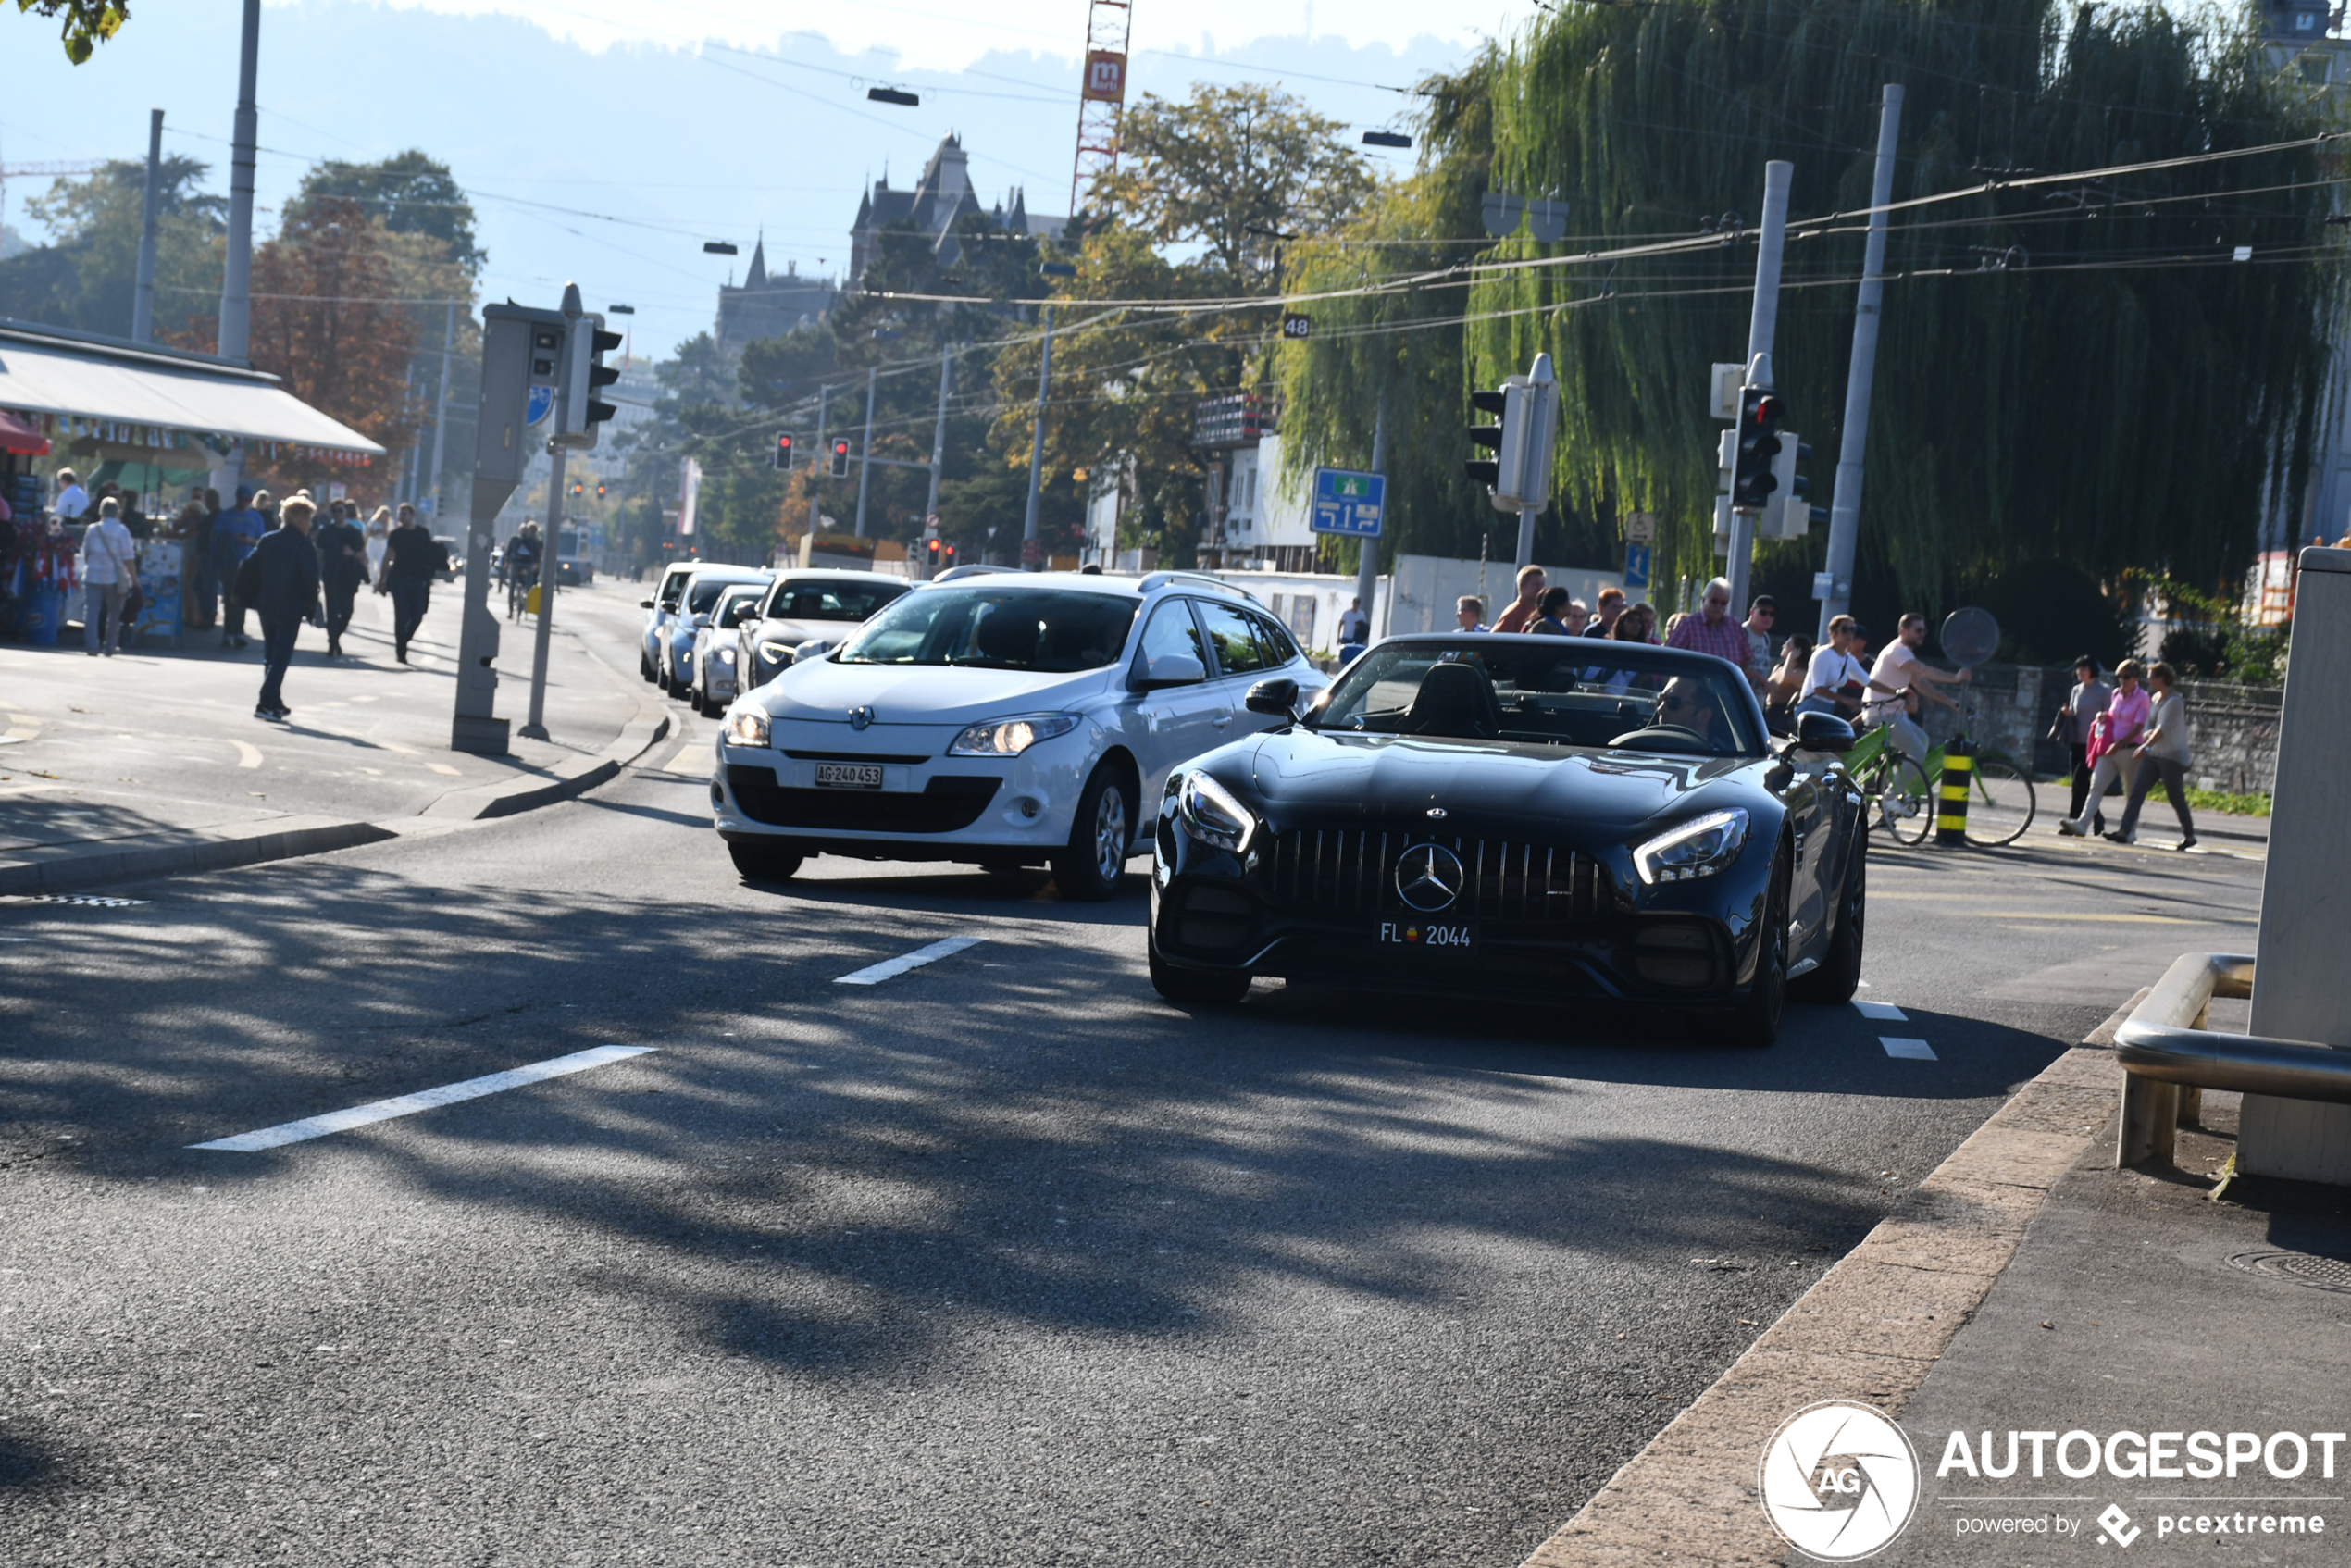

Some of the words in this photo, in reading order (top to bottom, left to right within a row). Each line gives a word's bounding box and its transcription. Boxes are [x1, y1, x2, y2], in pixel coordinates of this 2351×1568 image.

[1285, 318, 1309, 335] 48
[1381, 922, 1402, 942] FL
[1426, 925, 1471, 946] 2044
